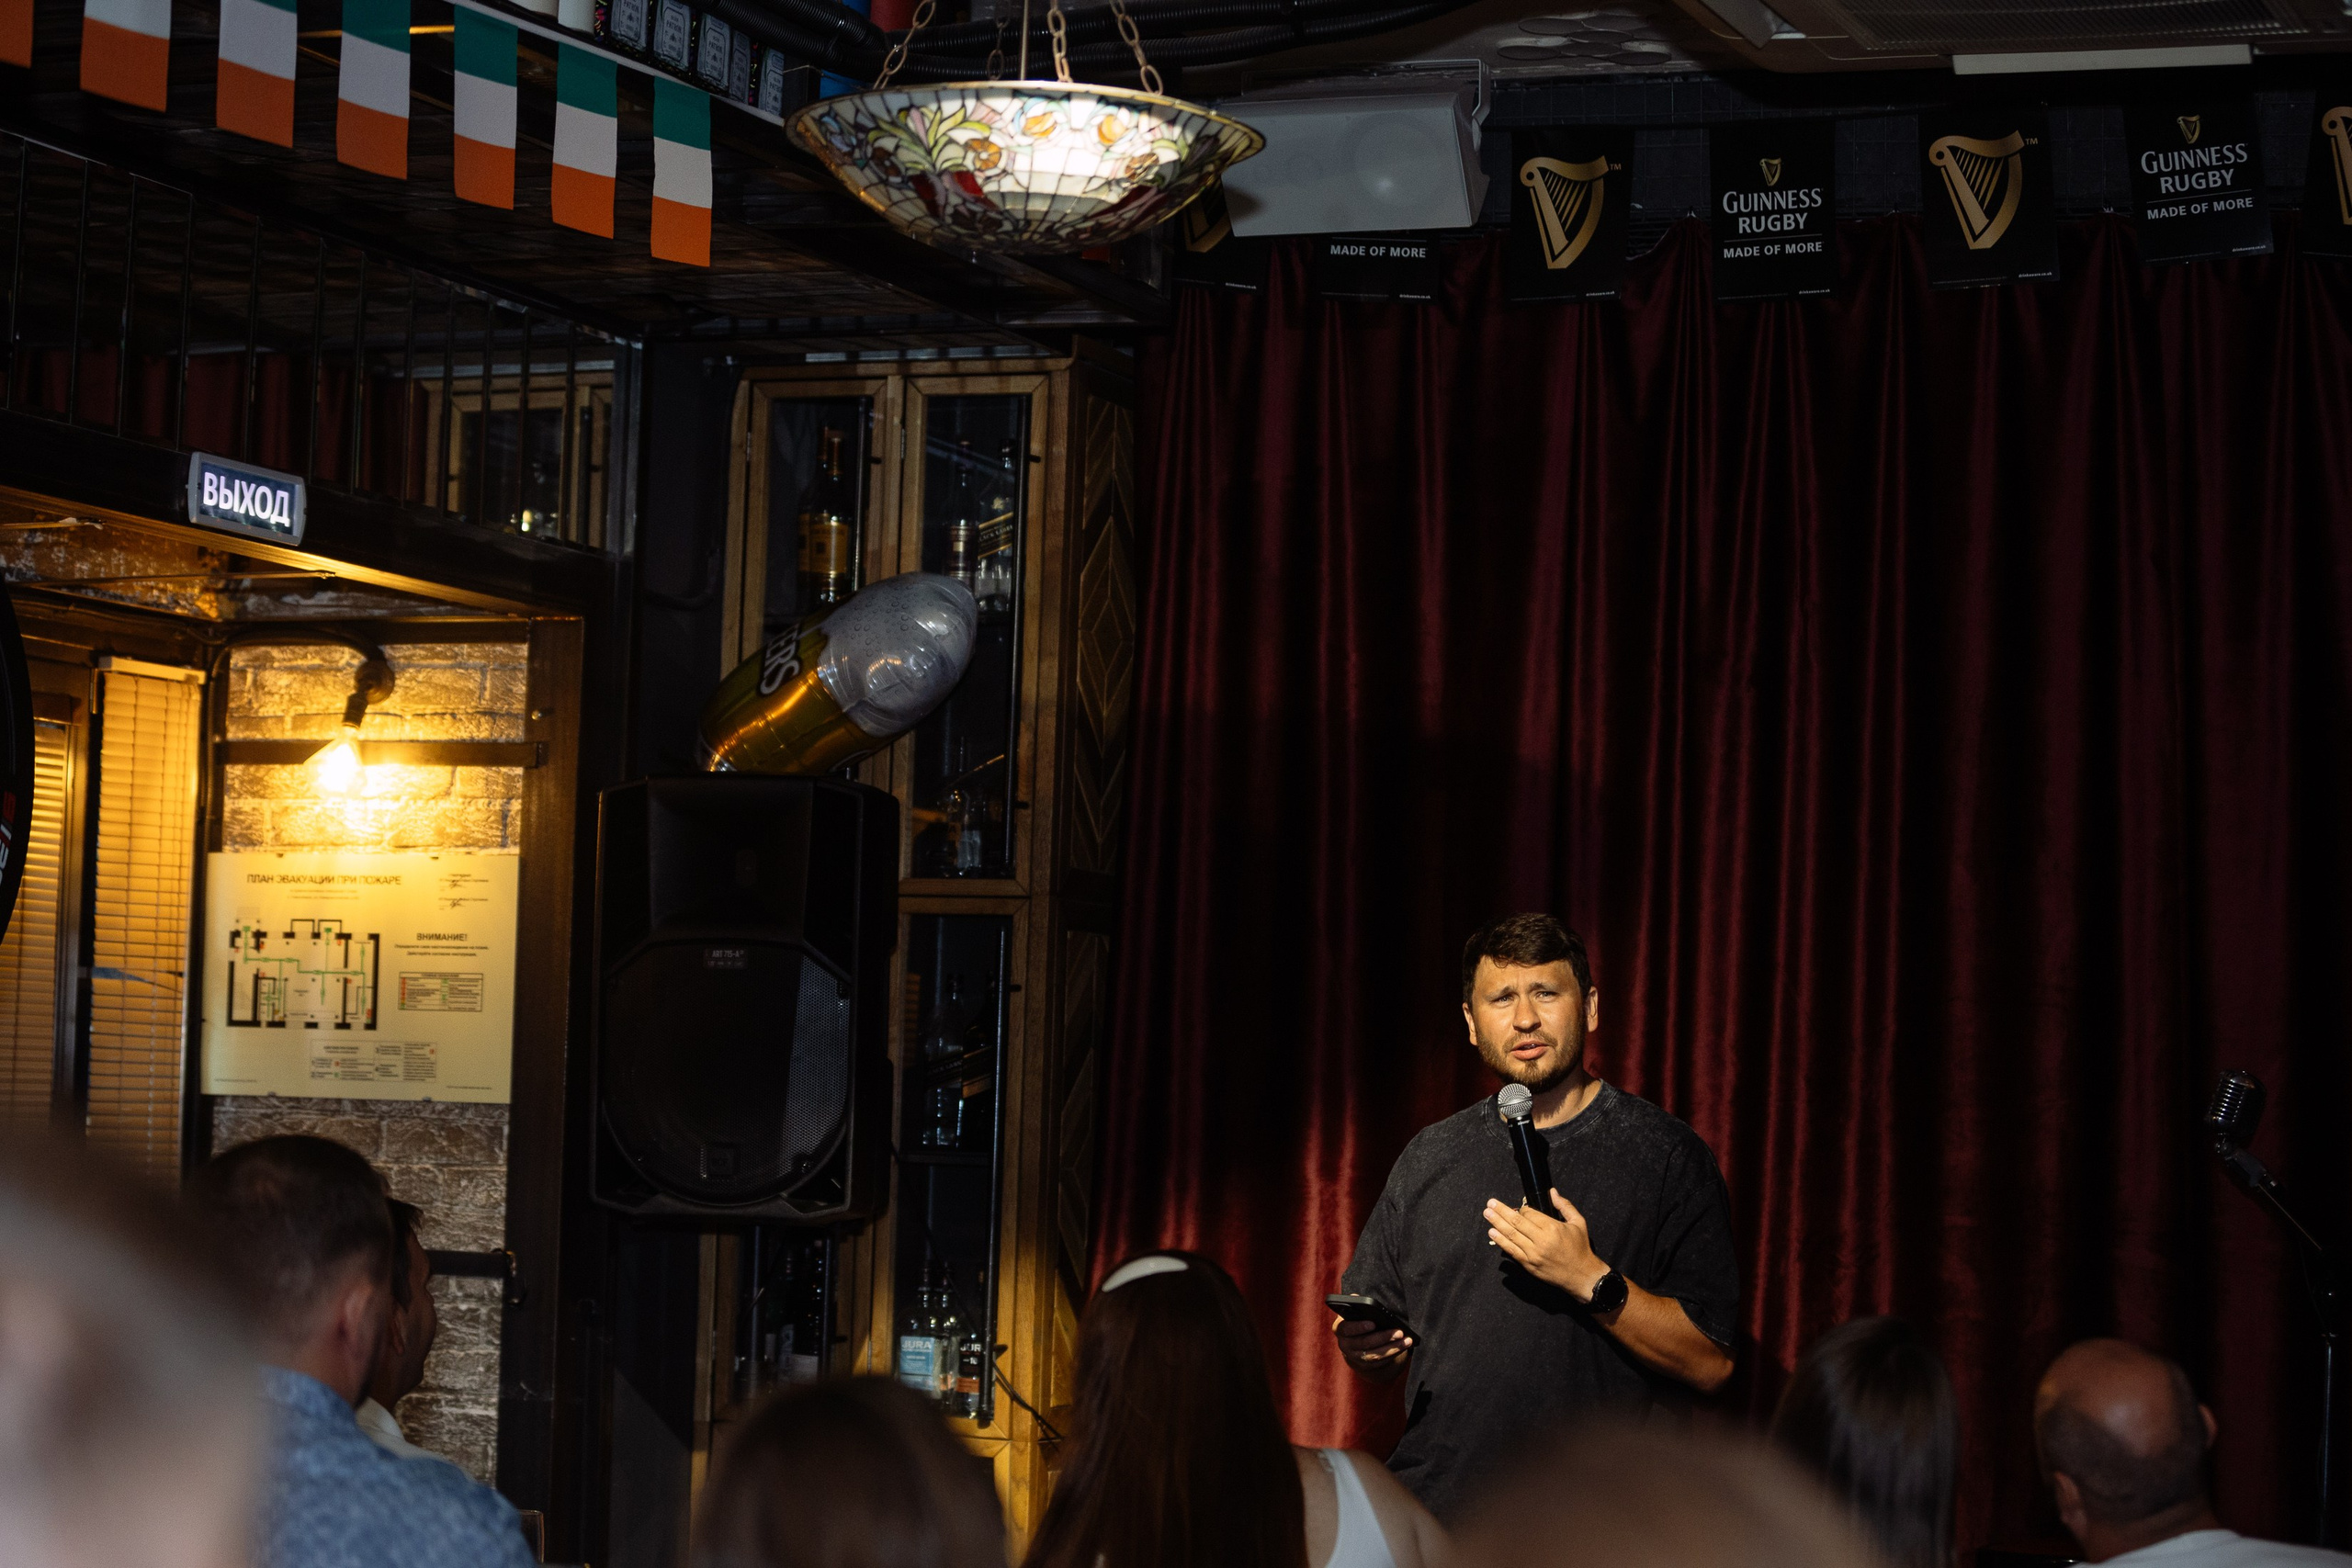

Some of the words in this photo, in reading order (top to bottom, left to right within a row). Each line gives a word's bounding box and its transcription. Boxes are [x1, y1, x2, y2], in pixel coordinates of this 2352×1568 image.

[2141, 143, 2248, 175] GUINNESS
[2159, 168, 2234, 194] RUGBY
[1723, 187, 1823, 214] GUINNESS
[2147, 205, 2187, 220] MADE
[2190, 202, 2209, 214] OF
[2212, 197, 2254, 212] MORE
[1738, 212, 1808, 234] RUGBY
[1329, 244, 1366, 256] MADE
[1369, 245, 1386, 256] OF
[1389, 247, 1427, 258] MORE
[1724, 245, 1760, 258] MADE
[1764, 244, 1781, 255] OF
[1785, 242, 1823, 254] MORE
[202, 471, 290, 527] ВЫХОД
[246, 874, 274, 884] ПЛАН
[277, 874, 334, 885] ЭВАКУАЦИИ
[337, 874, 356, 884] ПРИ
[358, 875, 401, 886] ПОЖАРЕ
[416, 932, 468, 942] ВНИМАНИЕ!
[902, 1340, 932, 1349] JURA
